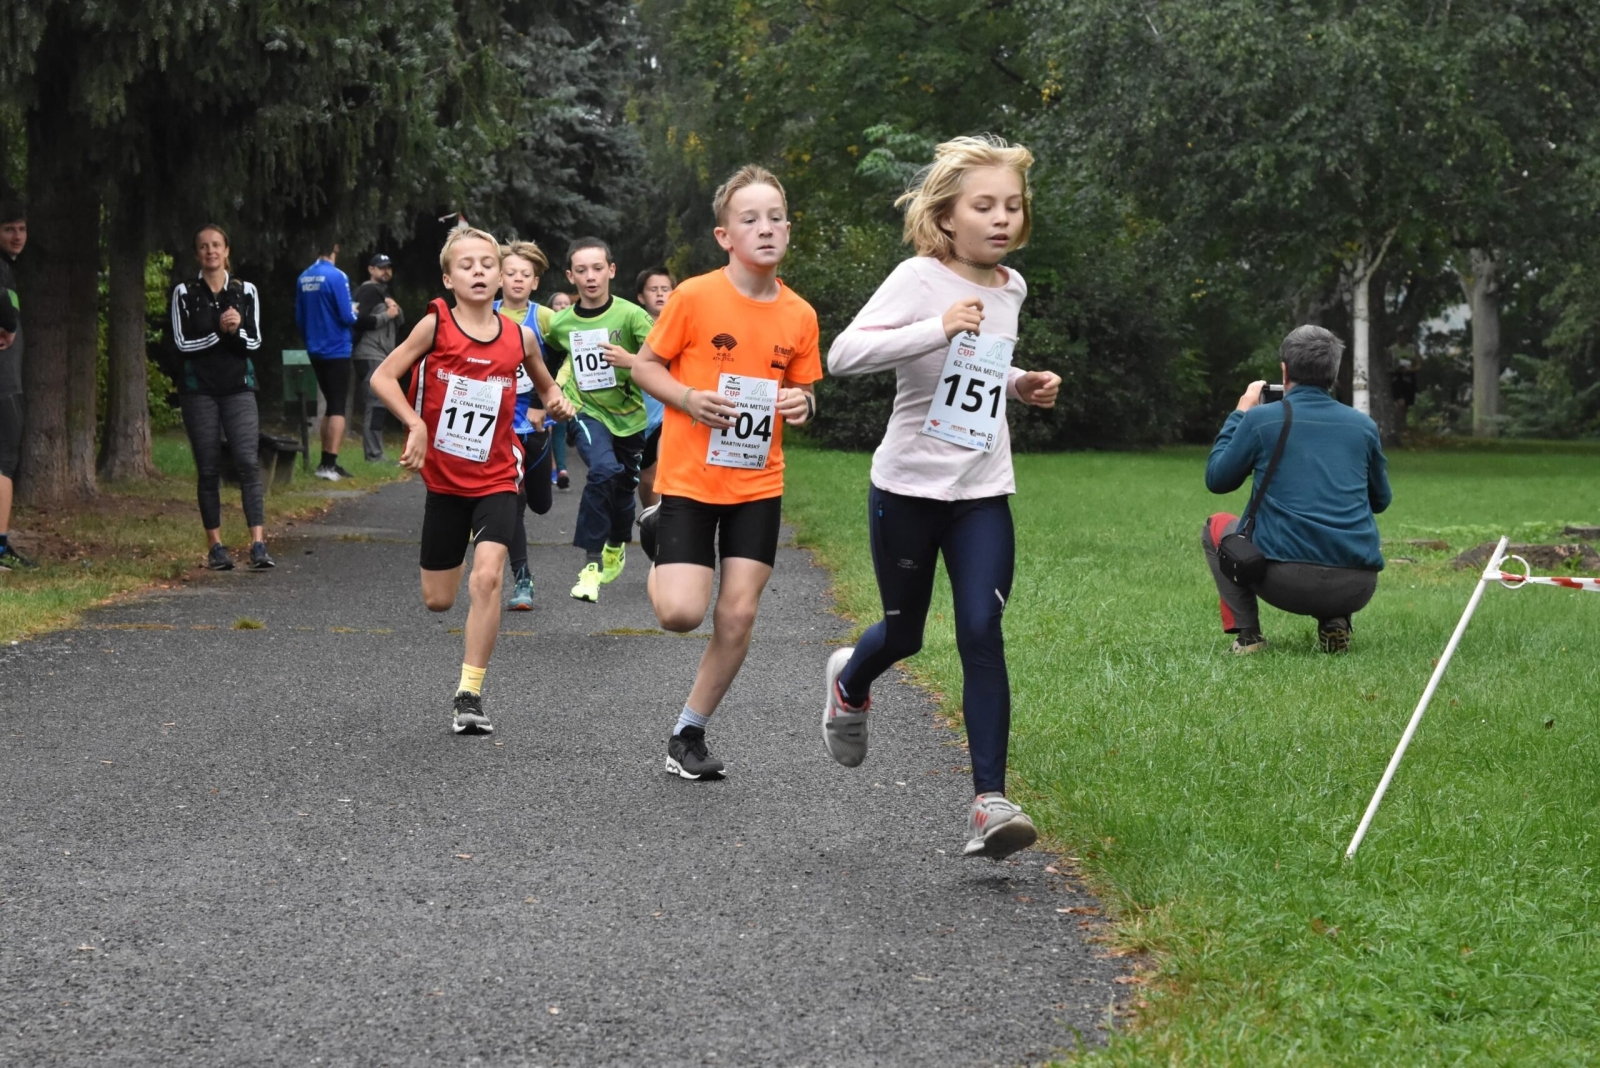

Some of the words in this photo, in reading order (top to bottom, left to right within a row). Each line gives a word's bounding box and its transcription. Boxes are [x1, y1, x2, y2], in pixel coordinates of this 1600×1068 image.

[957, 347, 975, 357] CUP
[574, 352, 611, 372] 105
[953, 360, 963, 368] 62.
[965, 363, 982, 373] CENA
[983, 368, 1004, 380] METUJE
[724, 389, 740, 397] CUP
[943, 373, 1002, 419] 151
[459, 400, 474, 408] CENA
[474, 403, 494, 412] METUJE
[750, 403, 771, 412] METUJE
[445, 406, 496, 437] 117
[721, 440, 741, 448] MARTIN
